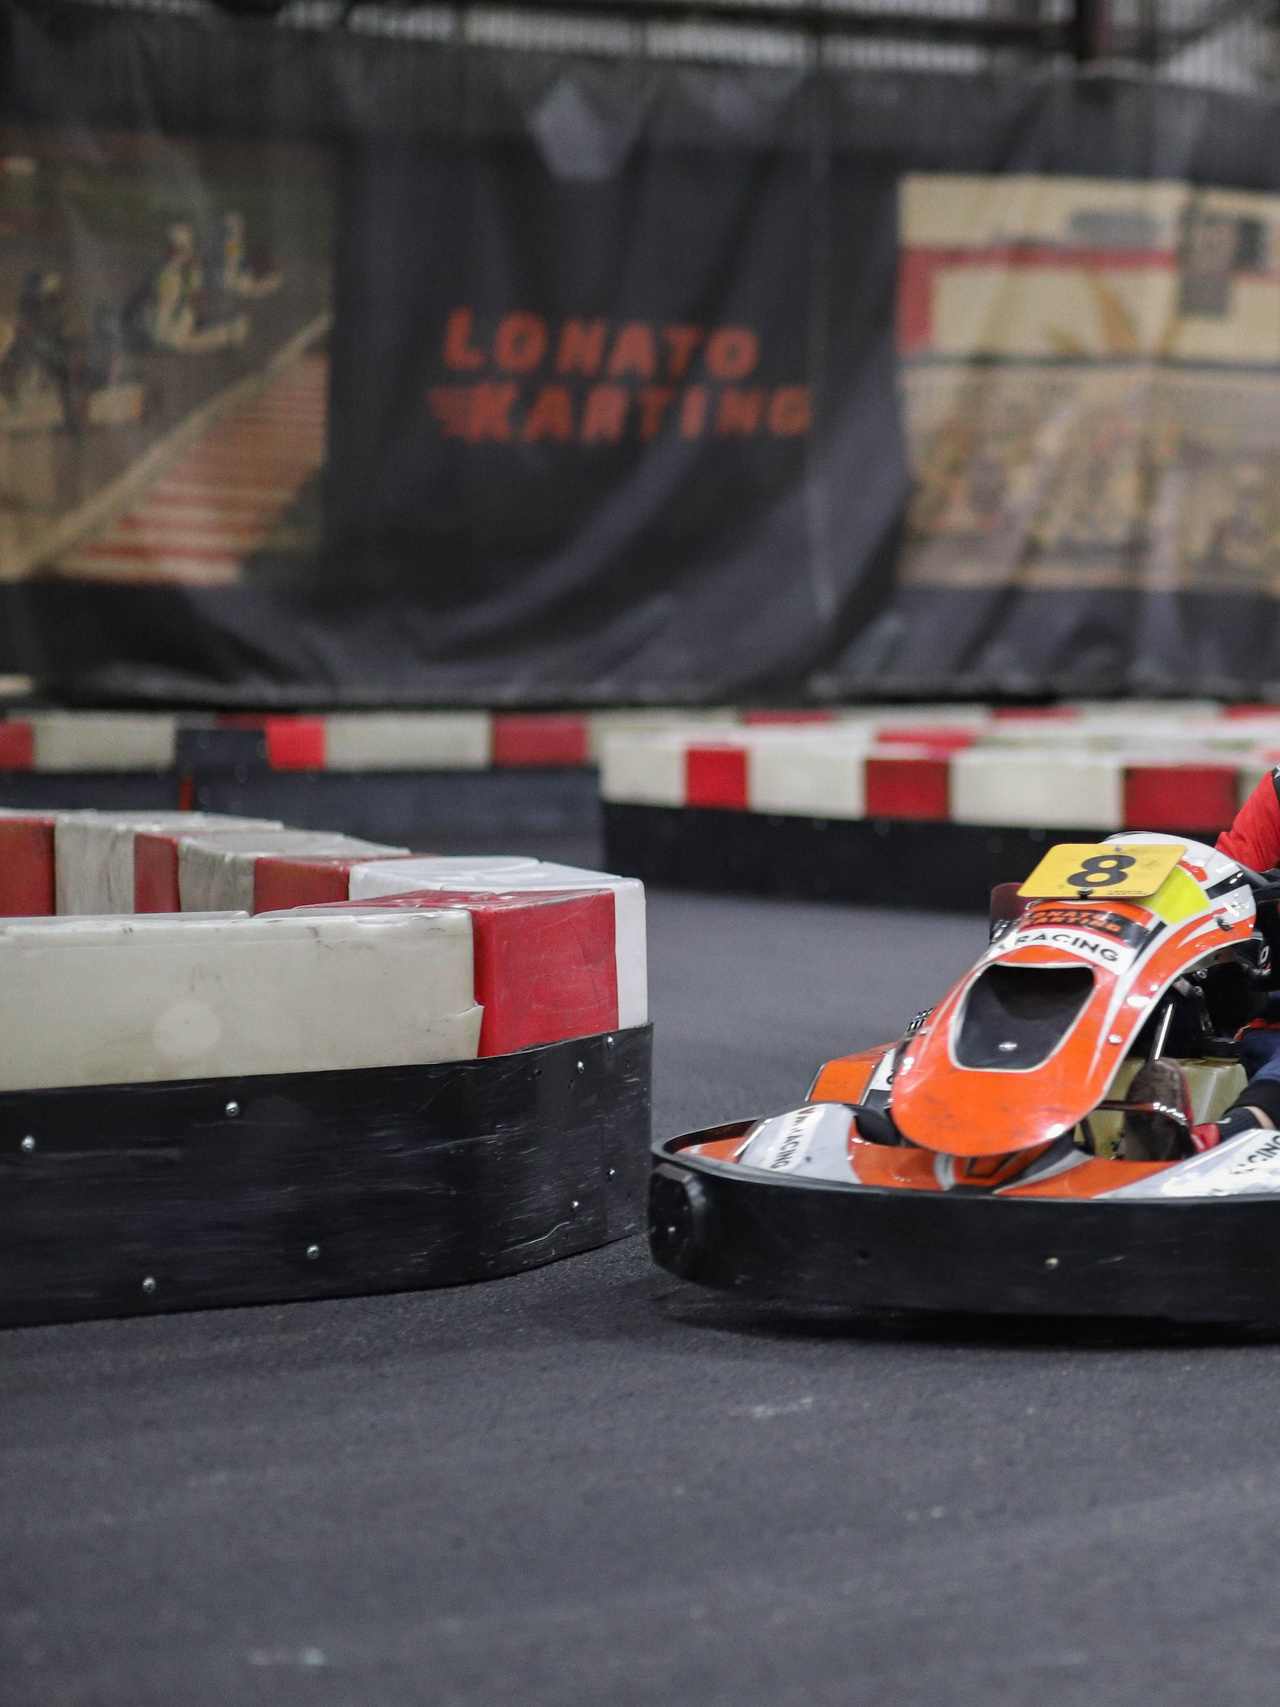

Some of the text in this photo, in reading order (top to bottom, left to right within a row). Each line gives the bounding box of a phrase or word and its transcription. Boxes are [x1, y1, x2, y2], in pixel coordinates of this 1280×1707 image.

[442, 304, 760, 380] LONATO
[464, 381, 813, 445] KARTING
[1066, 854, 1137, 888] 8
